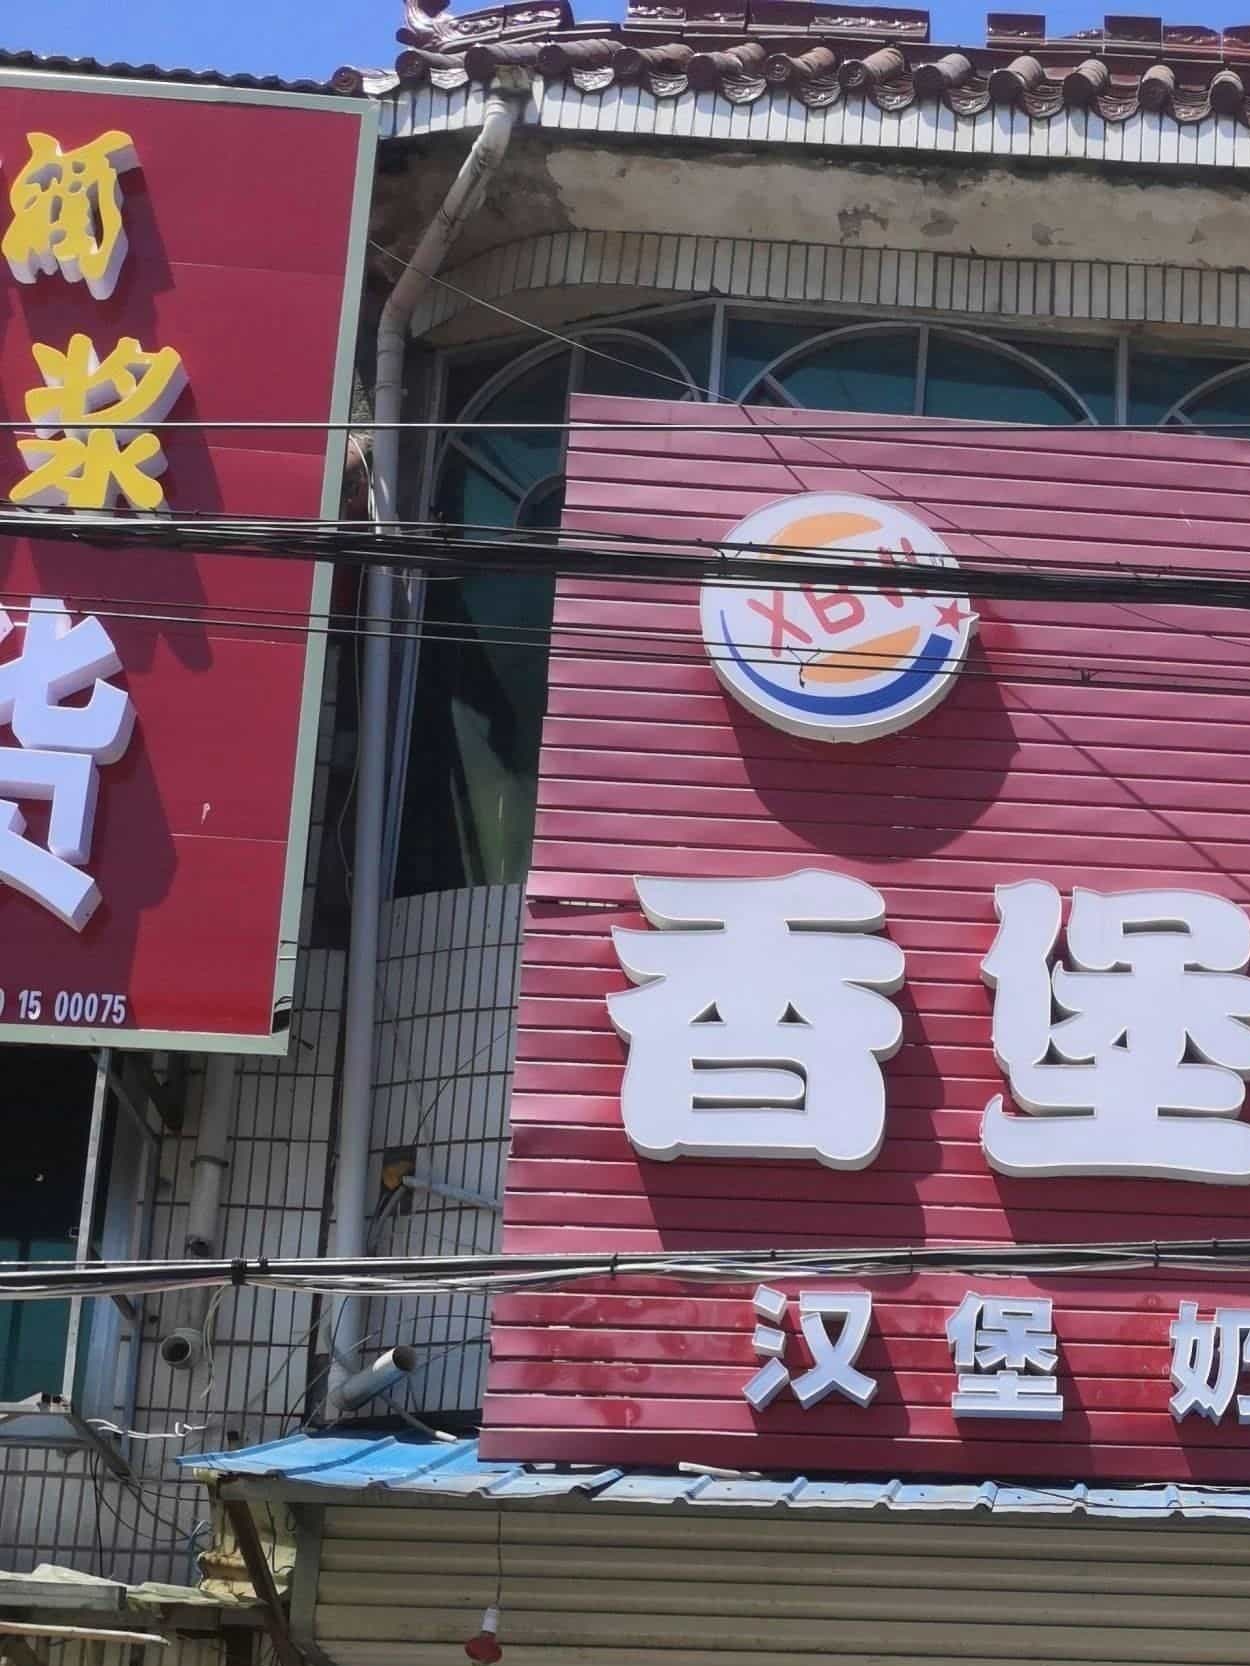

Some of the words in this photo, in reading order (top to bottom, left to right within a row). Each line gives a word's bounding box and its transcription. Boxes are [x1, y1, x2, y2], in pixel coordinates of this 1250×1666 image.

[9, 333, 189, 516] 浆
[18, 989, 43, 1020] 15
[54, 991, 126, 1024] 00075
